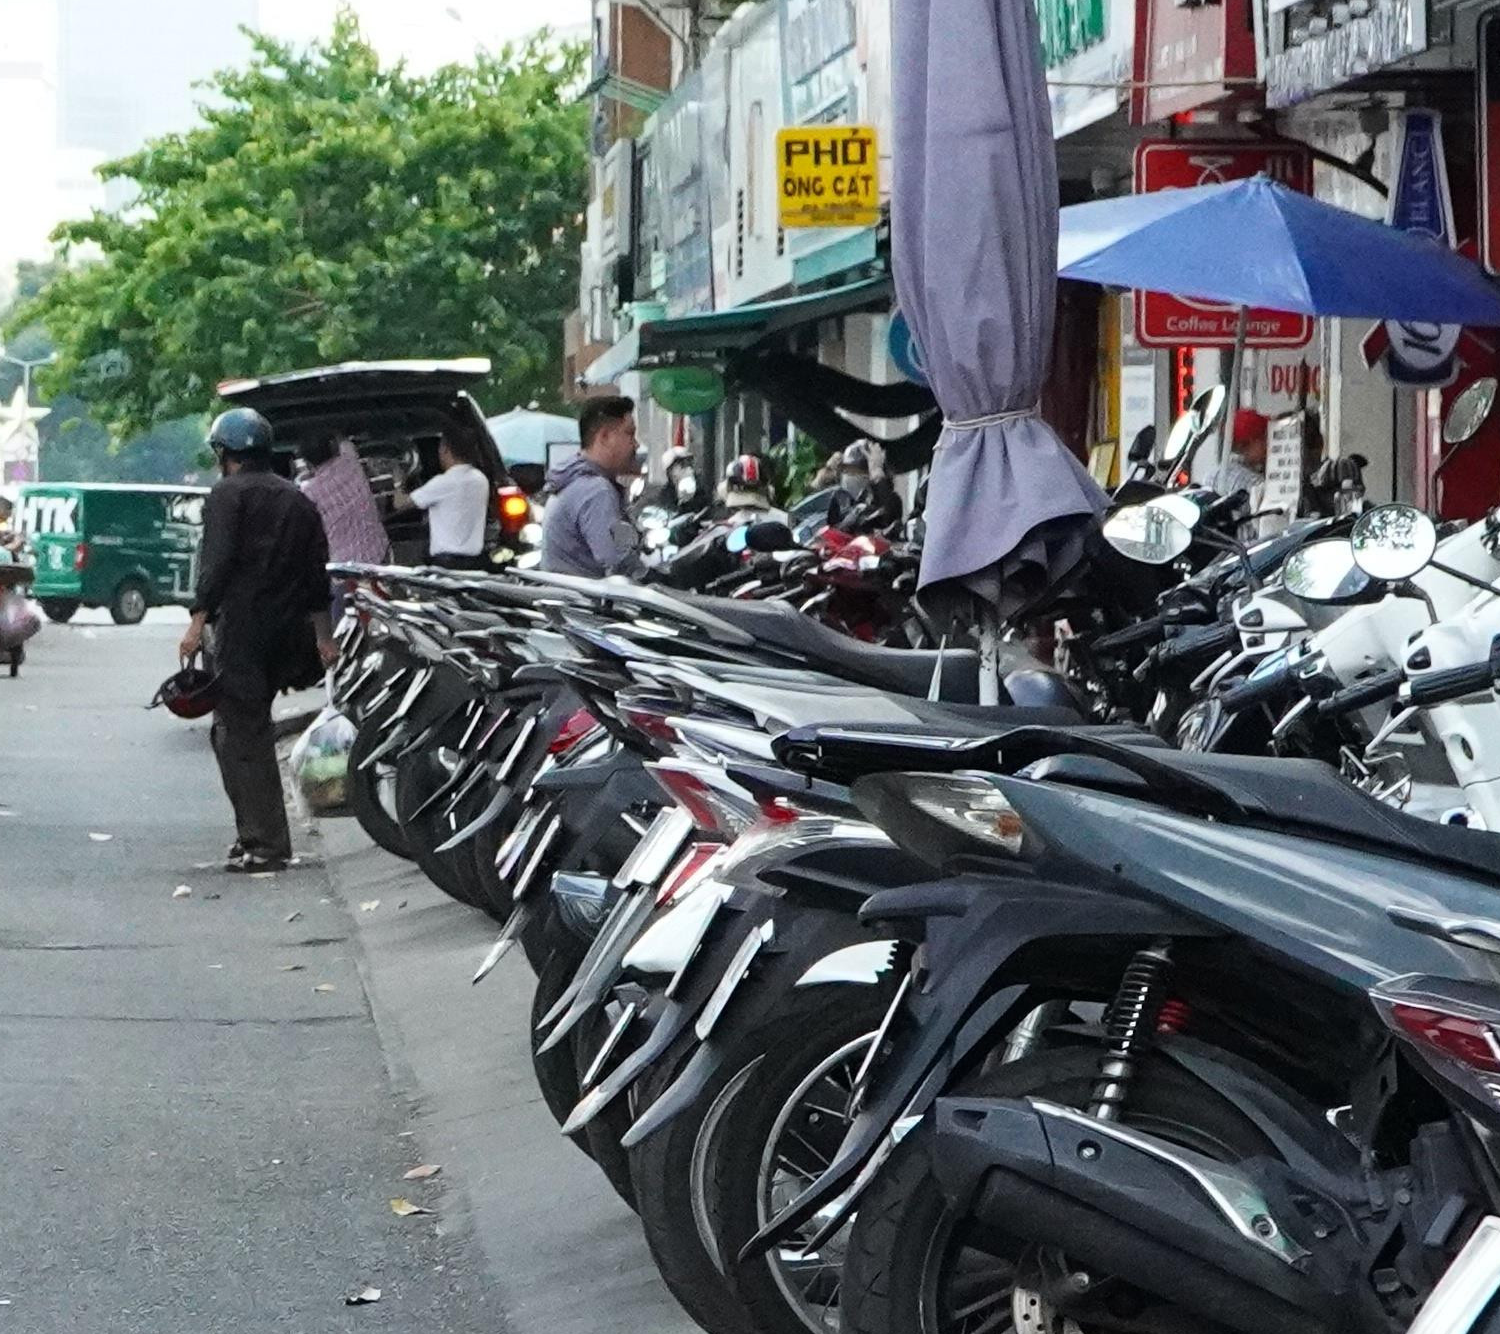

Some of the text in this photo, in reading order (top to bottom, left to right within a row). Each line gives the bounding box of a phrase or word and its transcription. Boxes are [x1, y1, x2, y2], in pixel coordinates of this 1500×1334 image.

[784, 128, 873, 167] PHỞ
[1166, 315, 1217, 333] Coffee
[14, 496, 79, 535] HTK
